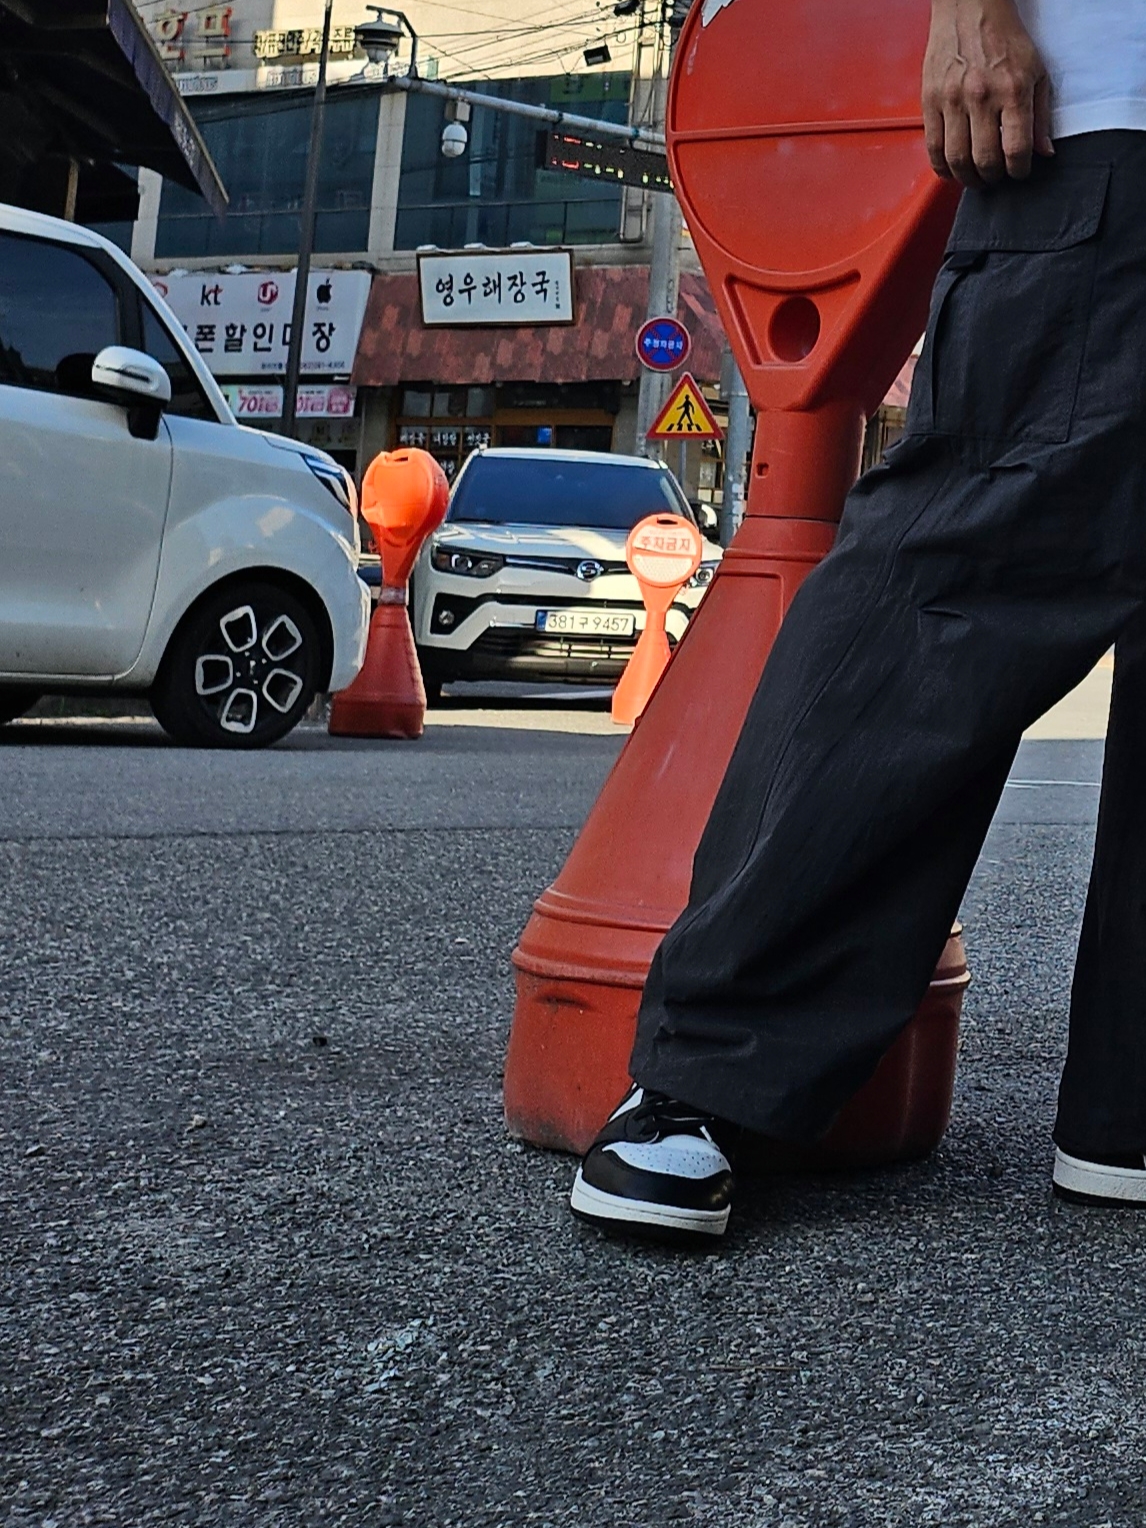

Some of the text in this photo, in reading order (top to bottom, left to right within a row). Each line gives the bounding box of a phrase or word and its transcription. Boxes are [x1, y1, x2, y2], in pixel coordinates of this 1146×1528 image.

[200, 284, 223, 306] kt
[435, 270, 551, 307] 영우해장국
[641, 535, 691, 552] 주차금지
[593, 616, 629, 632] 9457
